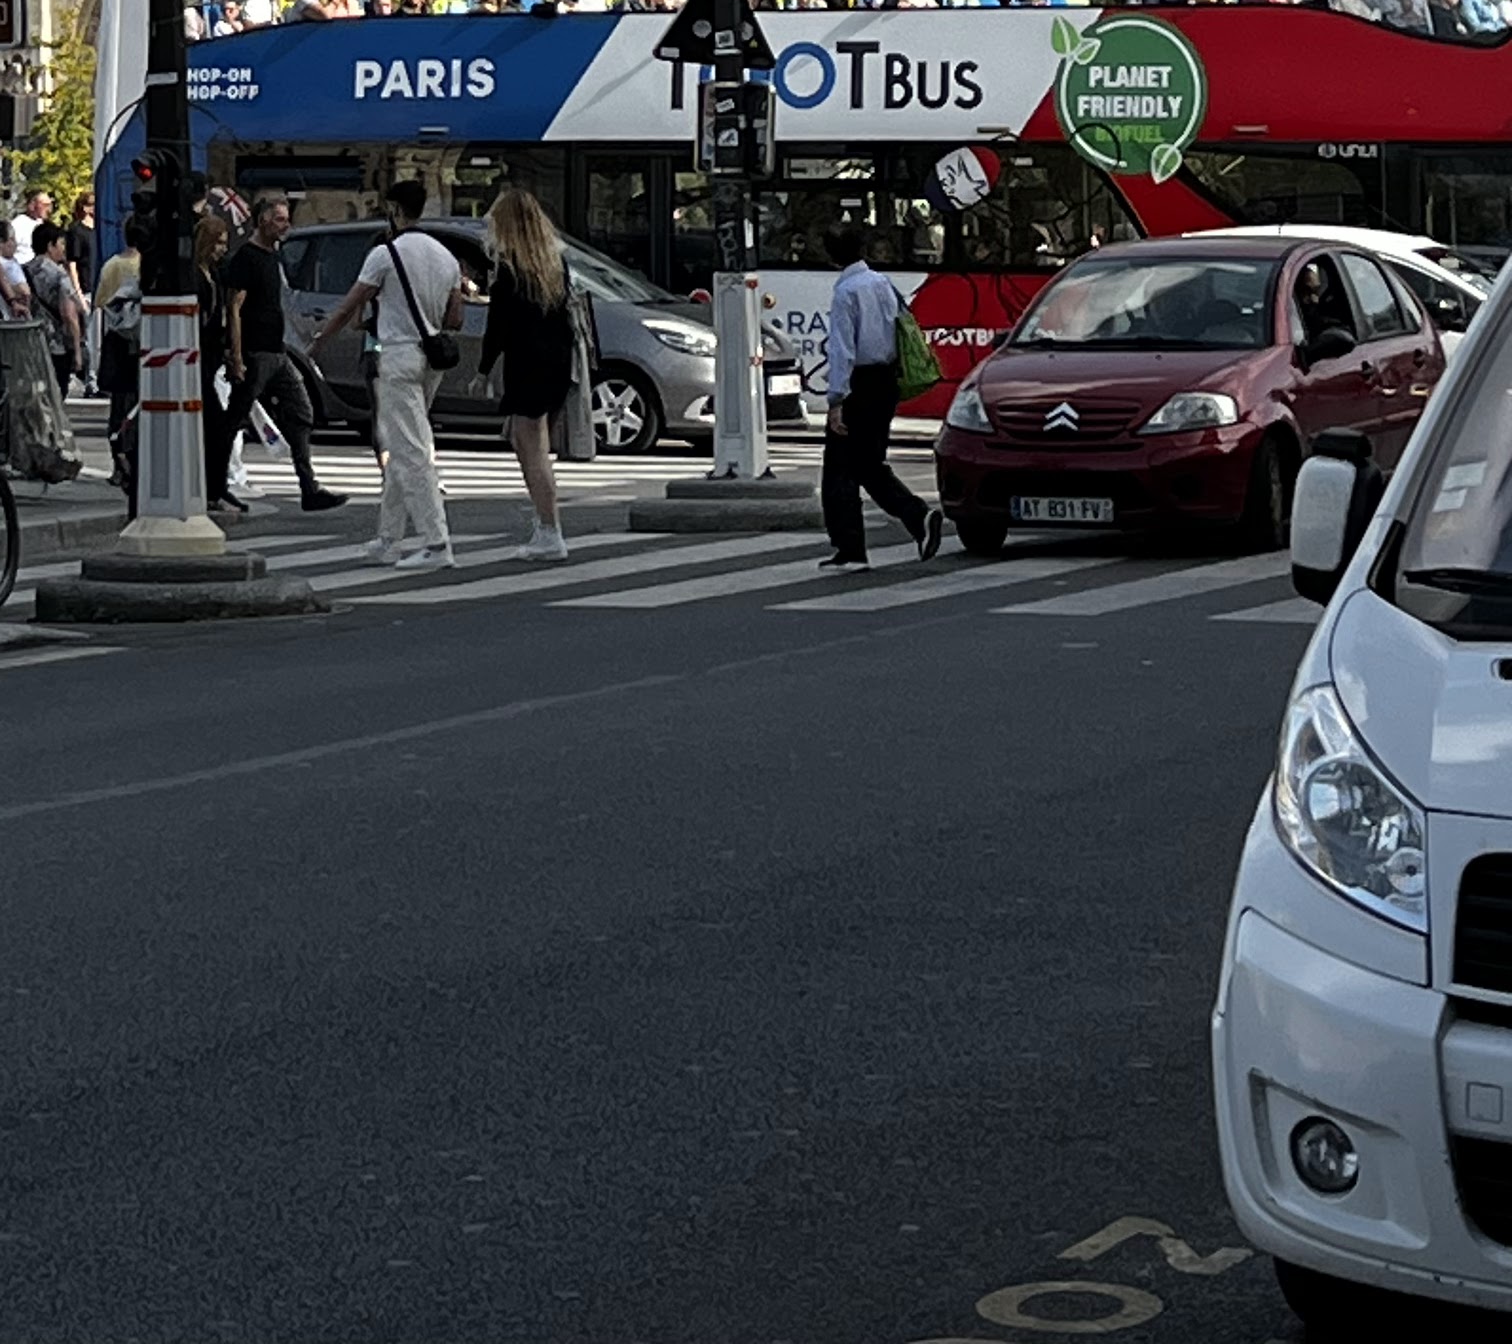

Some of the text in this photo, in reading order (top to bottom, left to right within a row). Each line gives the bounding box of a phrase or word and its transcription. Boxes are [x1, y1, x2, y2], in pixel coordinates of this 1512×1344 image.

[186, 67, 251, 83] HOP-ON
[354, 58, 496, 99] PARIS
[1088, 65, 1173, 89] PLANET
[186, 84, 260, 100] HOP-OFF
[1076, 94, 1183, 119] FRIENDLY
[787, 310, 830, 335] RA
